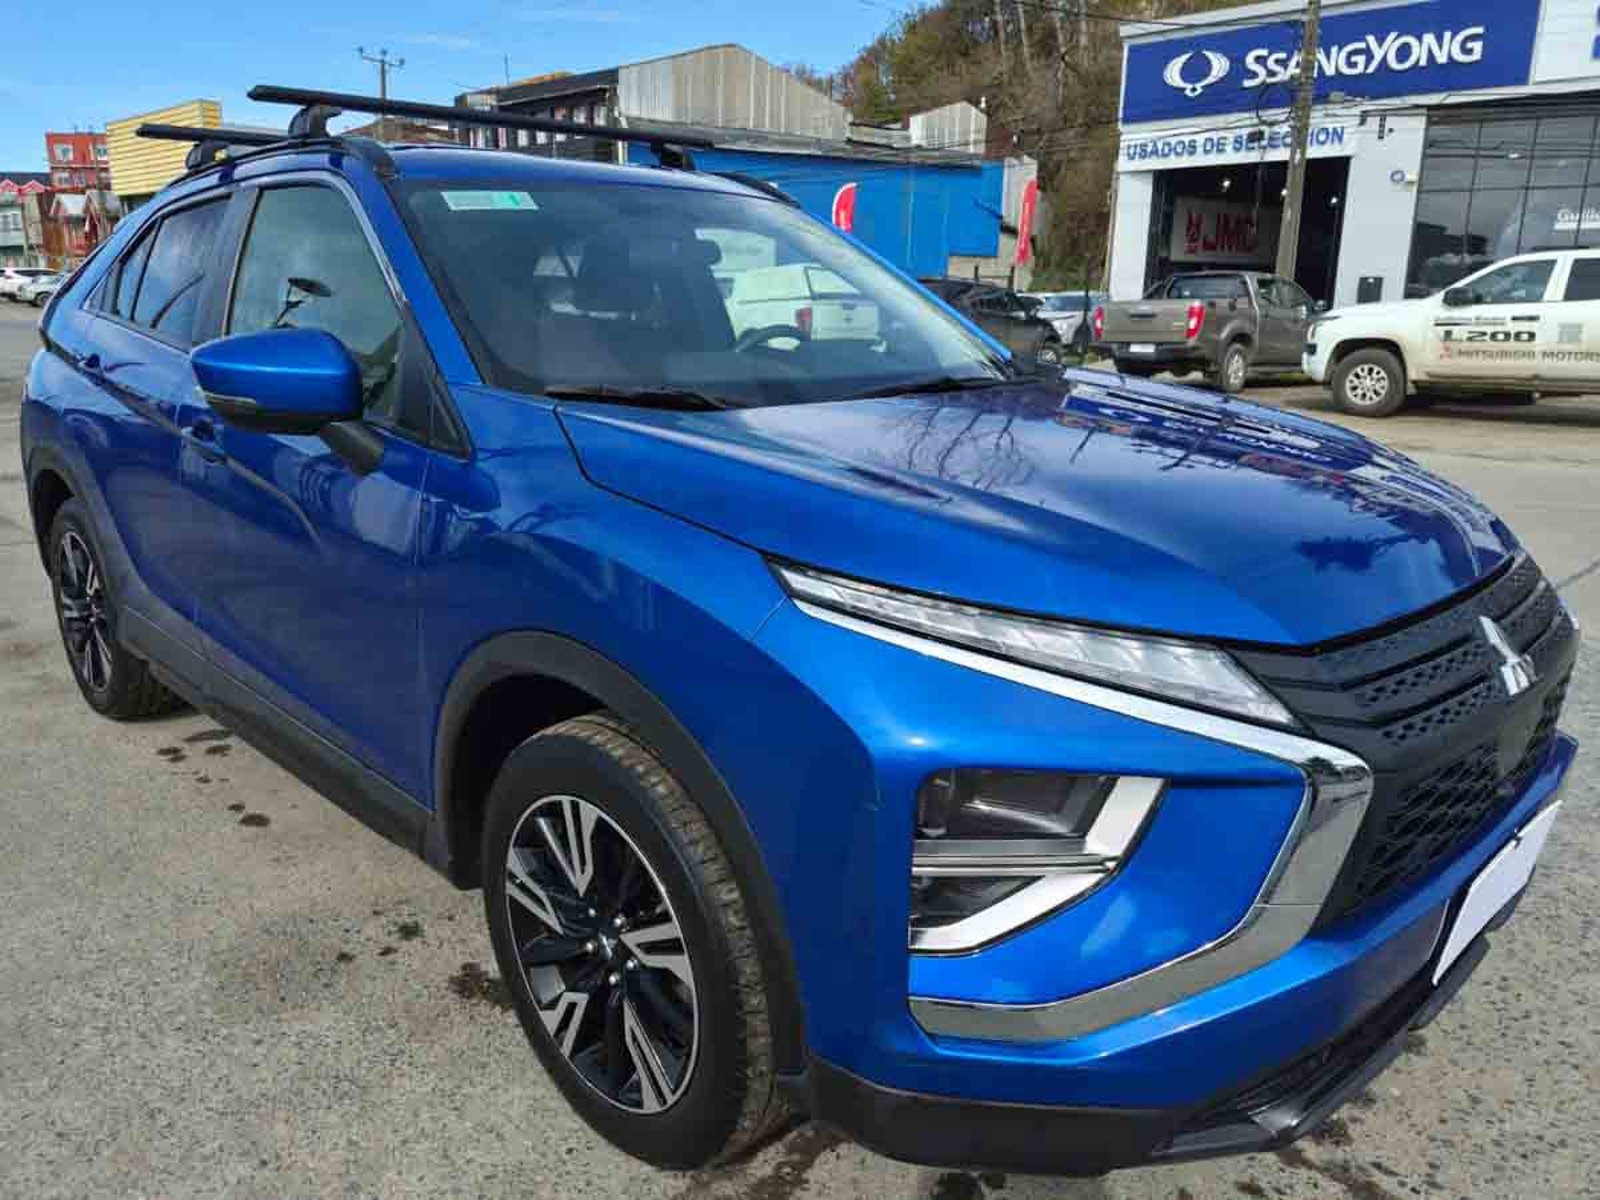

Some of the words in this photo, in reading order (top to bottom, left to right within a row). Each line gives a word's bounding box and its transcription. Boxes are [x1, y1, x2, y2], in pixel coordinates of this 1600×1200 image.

[1126, 138, 1197, 161] USADOS
[1203, 135, 1229, 154] DE
[1232, 126, 1345, 151] SELECION
[1443, 329, 1537, 343] L200
